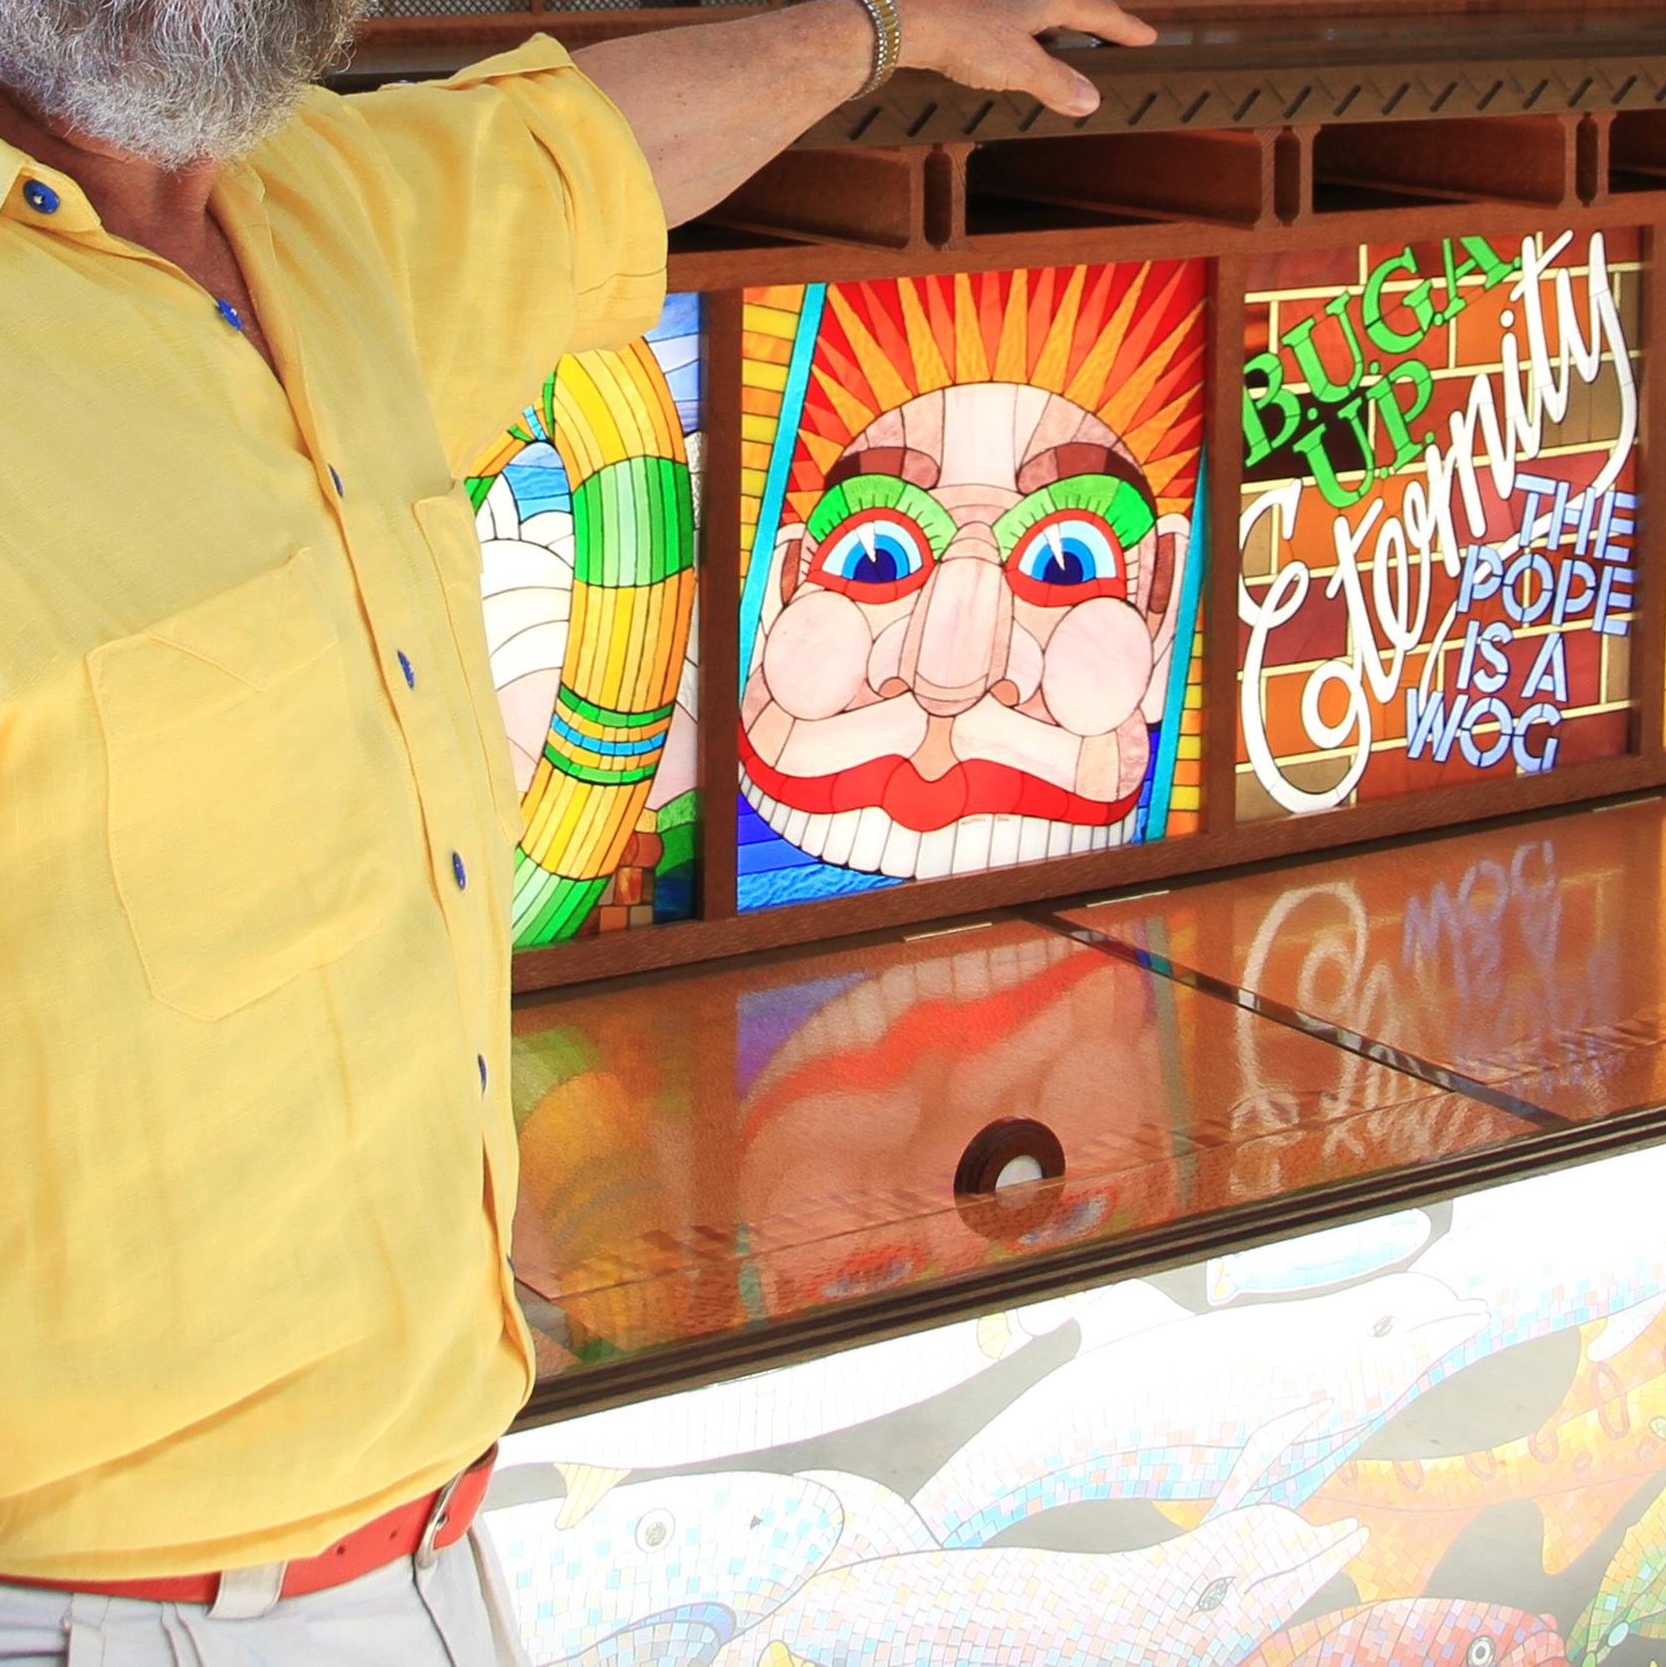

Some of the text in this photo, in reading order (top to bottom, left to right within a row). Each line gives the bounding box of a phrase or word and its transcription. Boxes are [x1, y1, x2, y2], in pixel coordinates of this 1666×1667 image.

[1239, 231, 1637, 814] Eternity
[1514, 473, 1637, 562] THE
[1456, 544, 1634, 636] POPE
[1456, 619, 1568, 702] IS A
[1405, 686, 1562, 772] WOG
